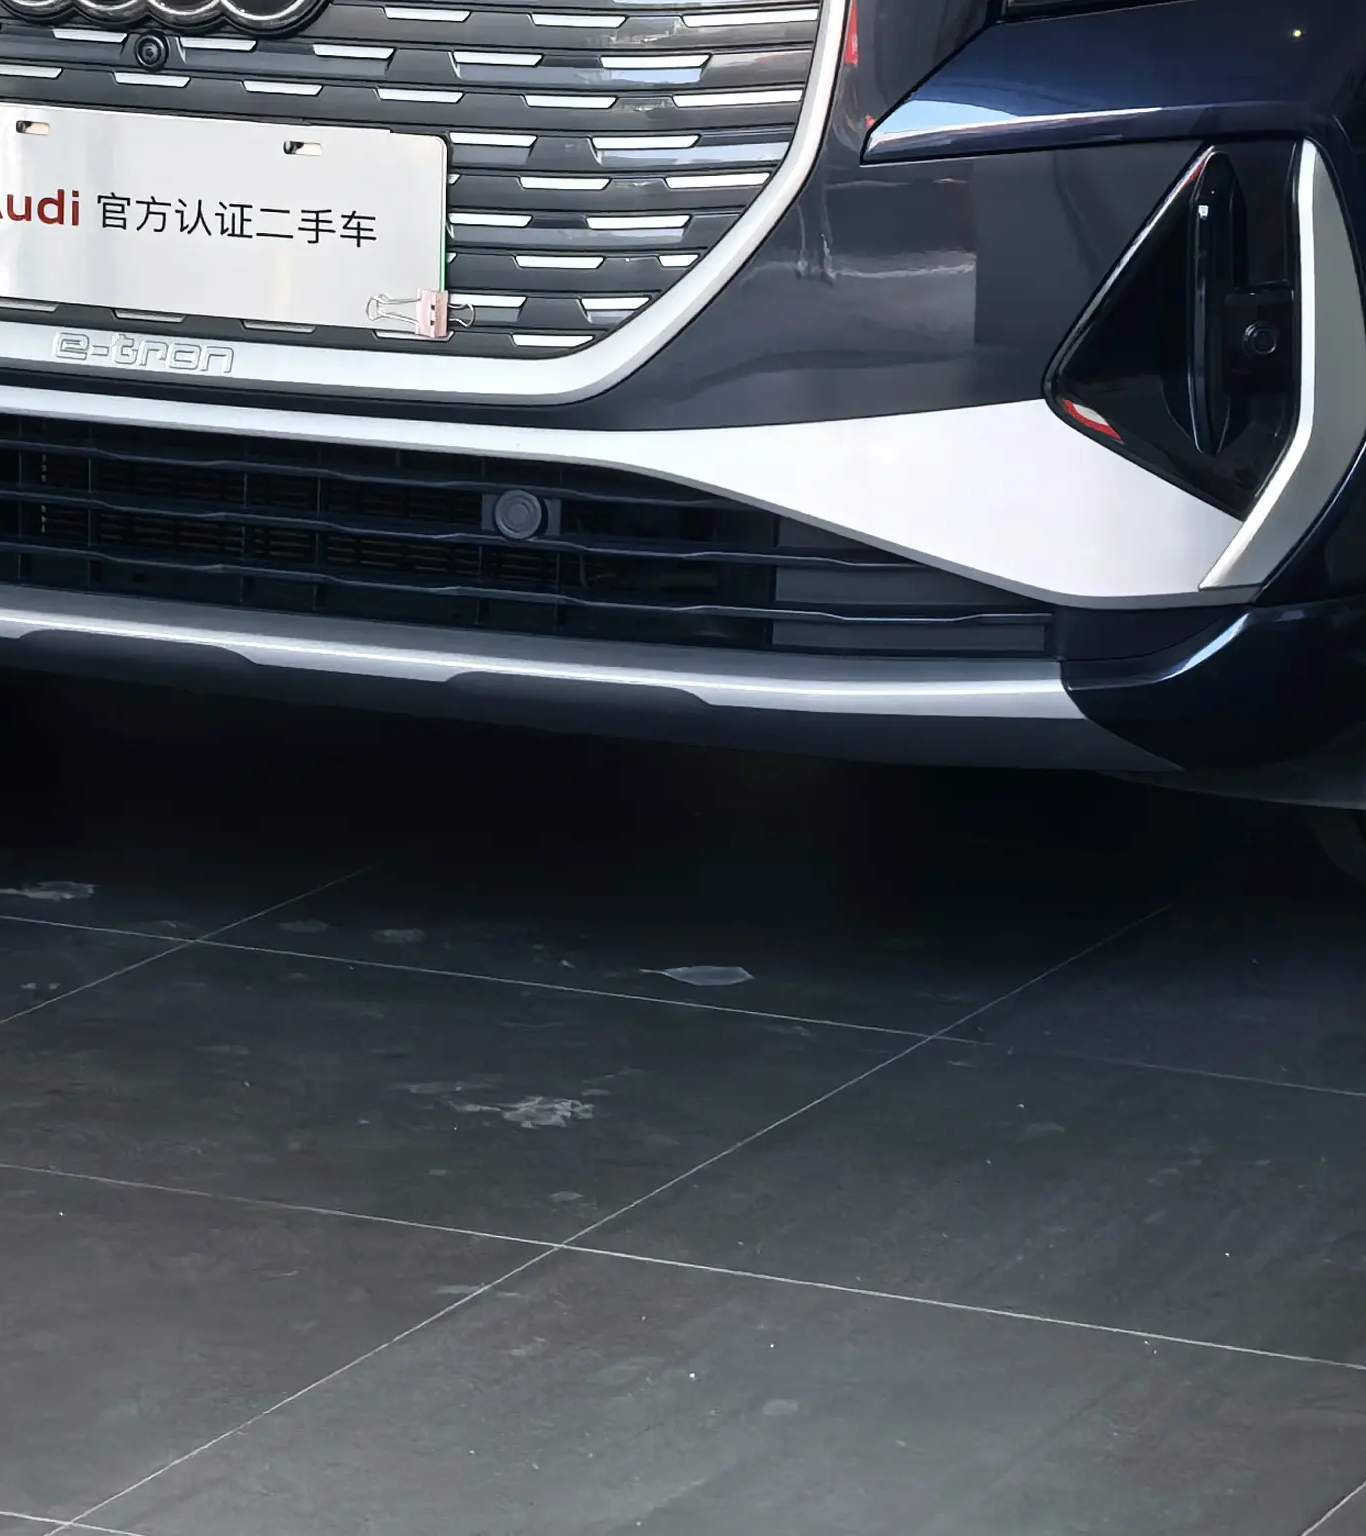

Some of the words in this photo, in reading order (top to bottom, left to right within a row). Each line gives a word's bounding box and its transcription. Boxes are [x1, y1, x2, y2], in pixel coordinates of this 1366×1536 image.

[96, 191, 378, 248] 官方认证二手车
[54, 332, 235, 374] e-tron
